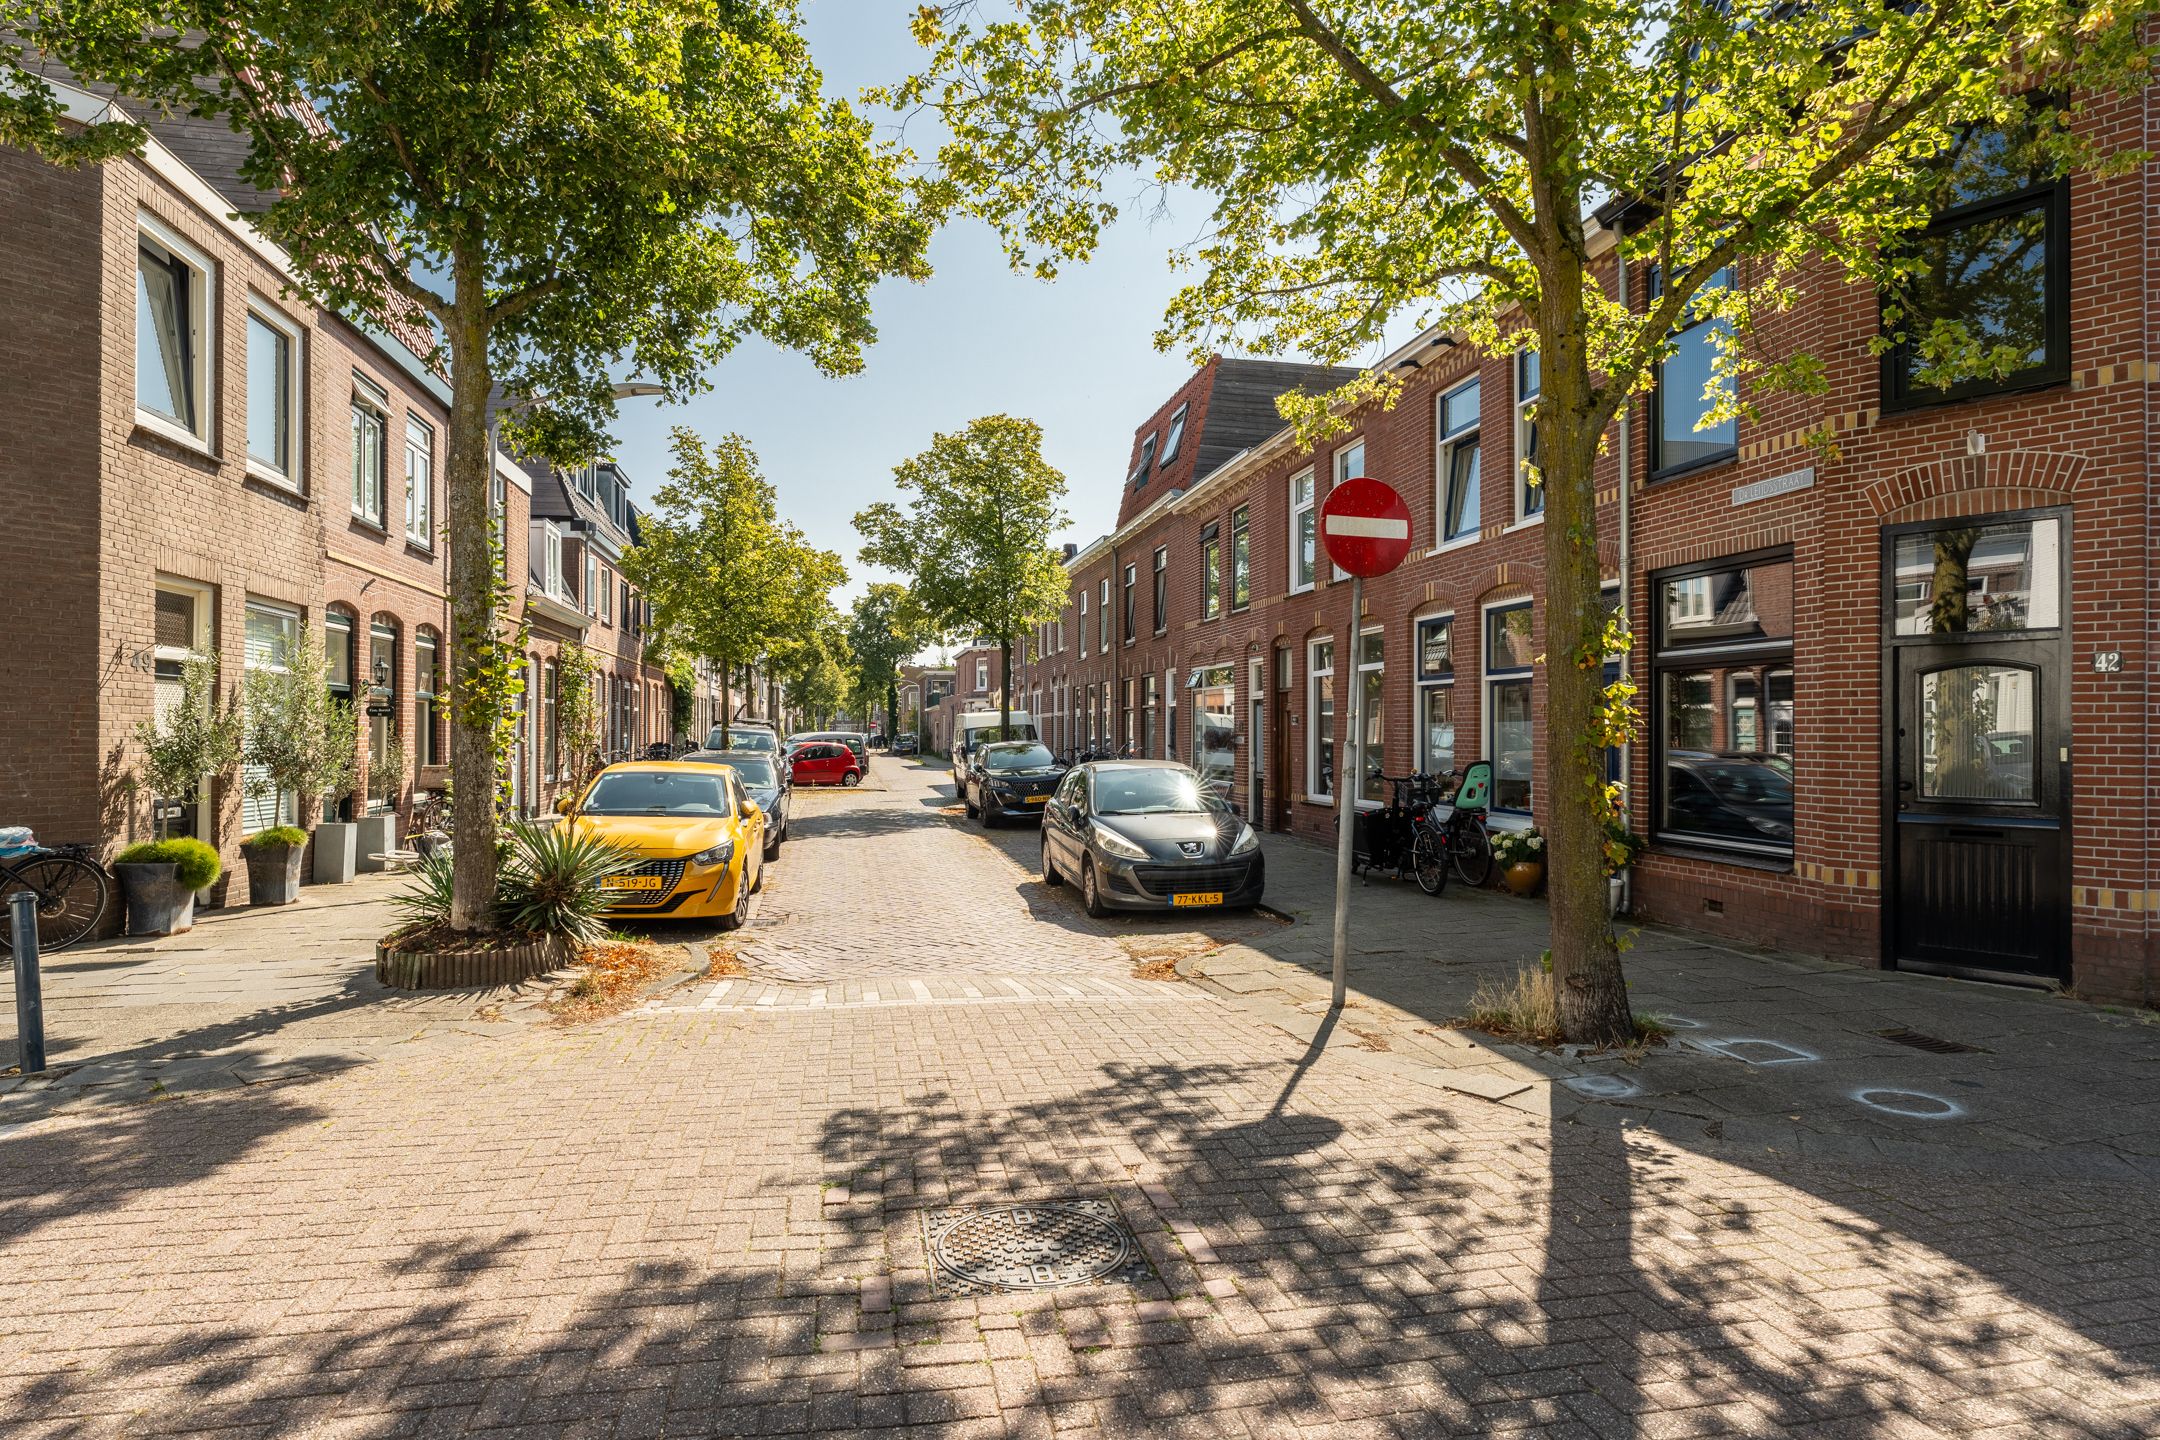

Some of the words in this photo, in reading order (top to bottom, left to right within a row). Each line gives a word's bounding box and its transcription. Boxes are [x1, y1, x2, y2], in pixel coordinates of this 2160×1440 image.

[132, 650, 151, 672] 49
[2095, 653, 2120, 672] 42
[606, 878, 656, 888] N-519-JG
[1177, 894, 1219, 904] 77-KKL-5
